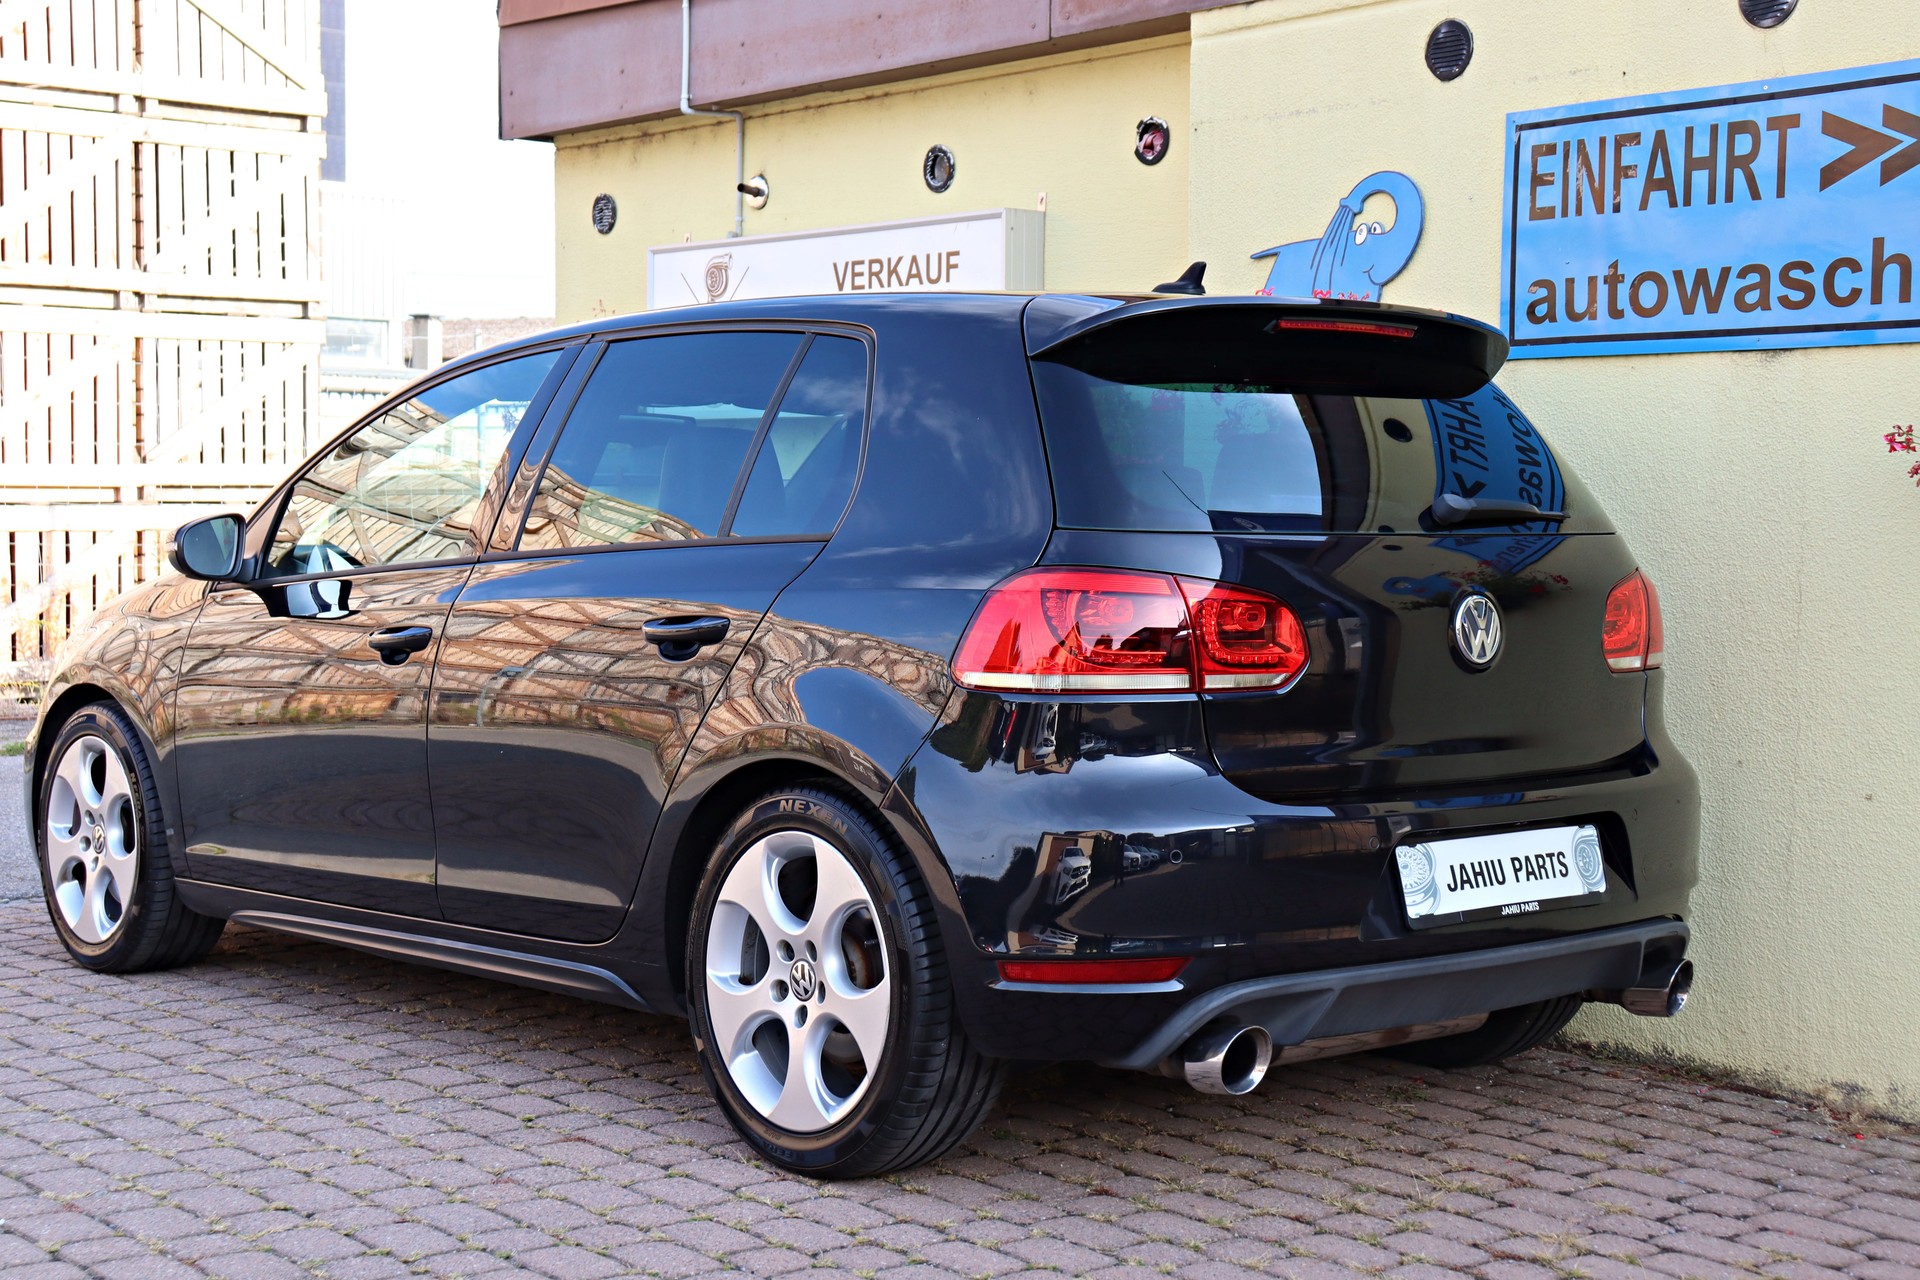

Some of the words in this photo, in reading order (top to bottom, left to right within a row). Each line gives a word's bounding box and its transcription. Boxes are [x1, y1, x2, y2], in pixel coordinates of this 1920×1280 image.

[1528, 113, 1801, 222] EINFAHRT
[832, 250, 961, 292] VERKAUF
[1526, 237, 1912, 325] autowasch
[1455, 594, 1501, 664] VW
[779, 799, 848, 836] NEXEN
[1446, 858, 1506, 893] JAHIU
[1510, 850, 1569, 884] PARTS
[1501, 904, 1521, 916] JAHIU
[1520, 901, 1540, 913] PARTS
